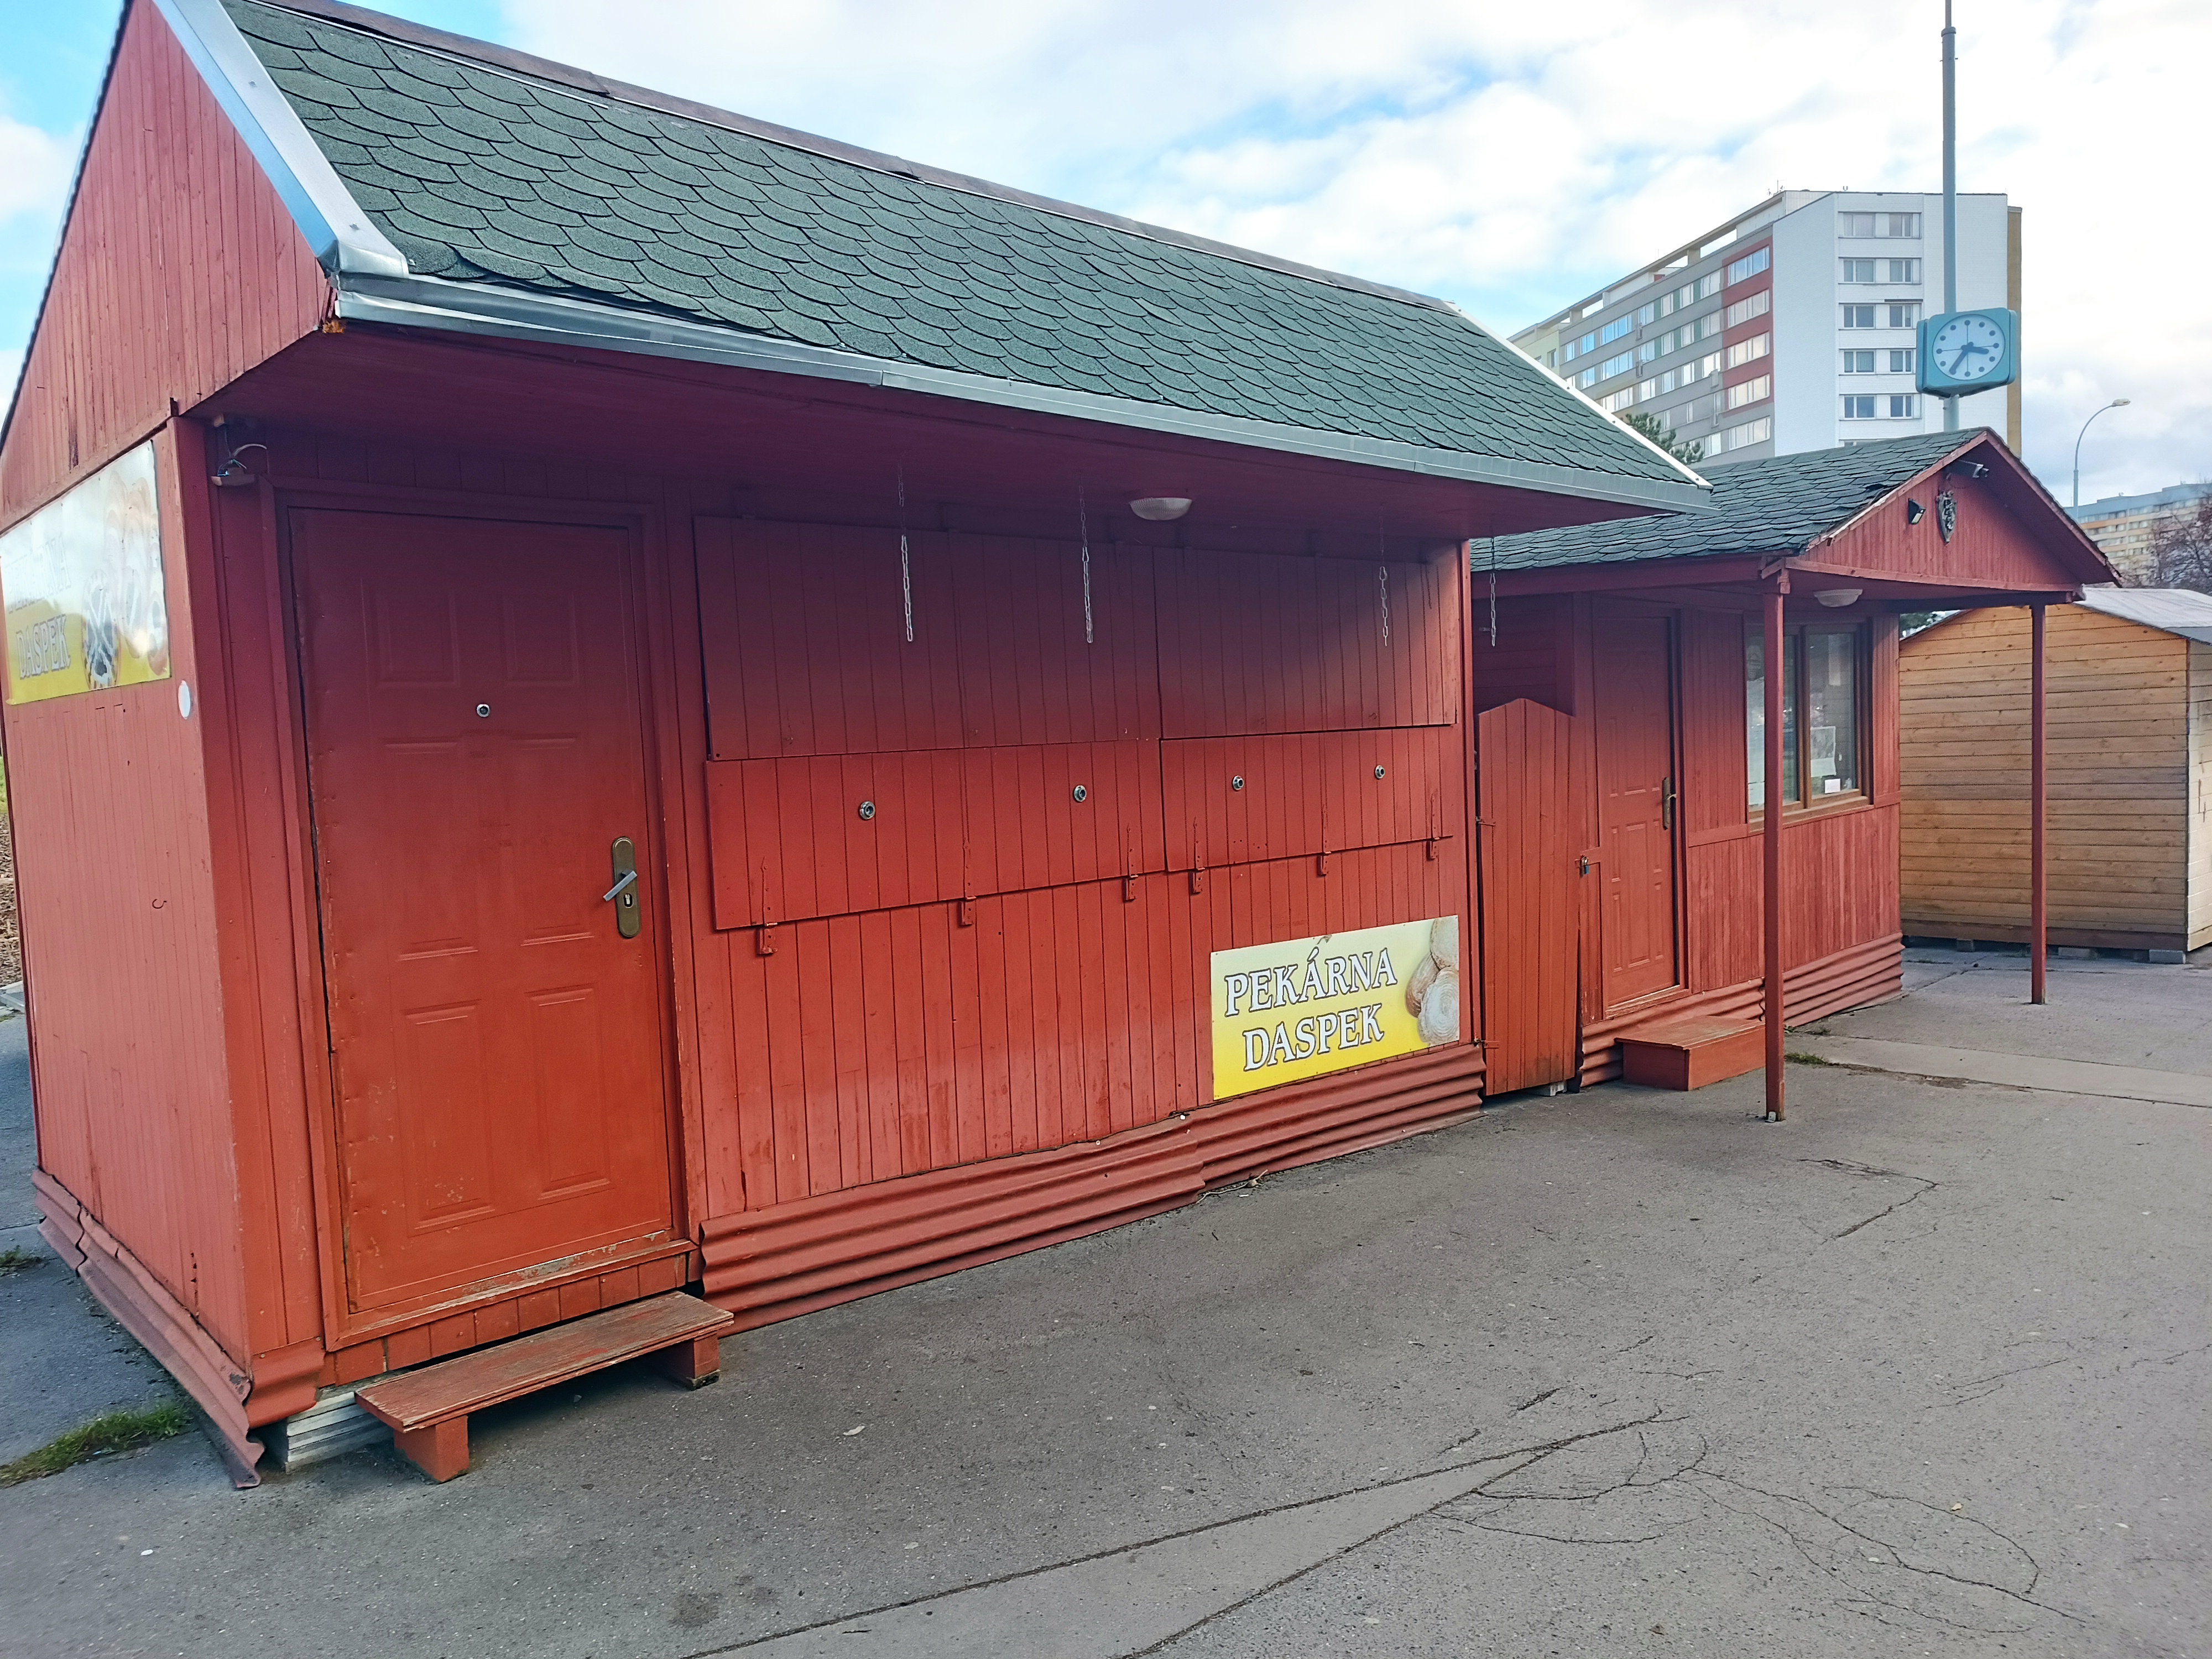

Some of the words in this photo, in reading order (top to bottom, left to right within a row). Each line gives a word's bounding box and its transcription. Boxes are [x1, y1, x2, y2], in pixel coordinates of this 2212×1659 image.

[15, 614, 71, 680] DASPEK
[1224, 946, 1397, 1017] PEKÁRNA
[1242, 1003, 1384, 1072] DASPEK
